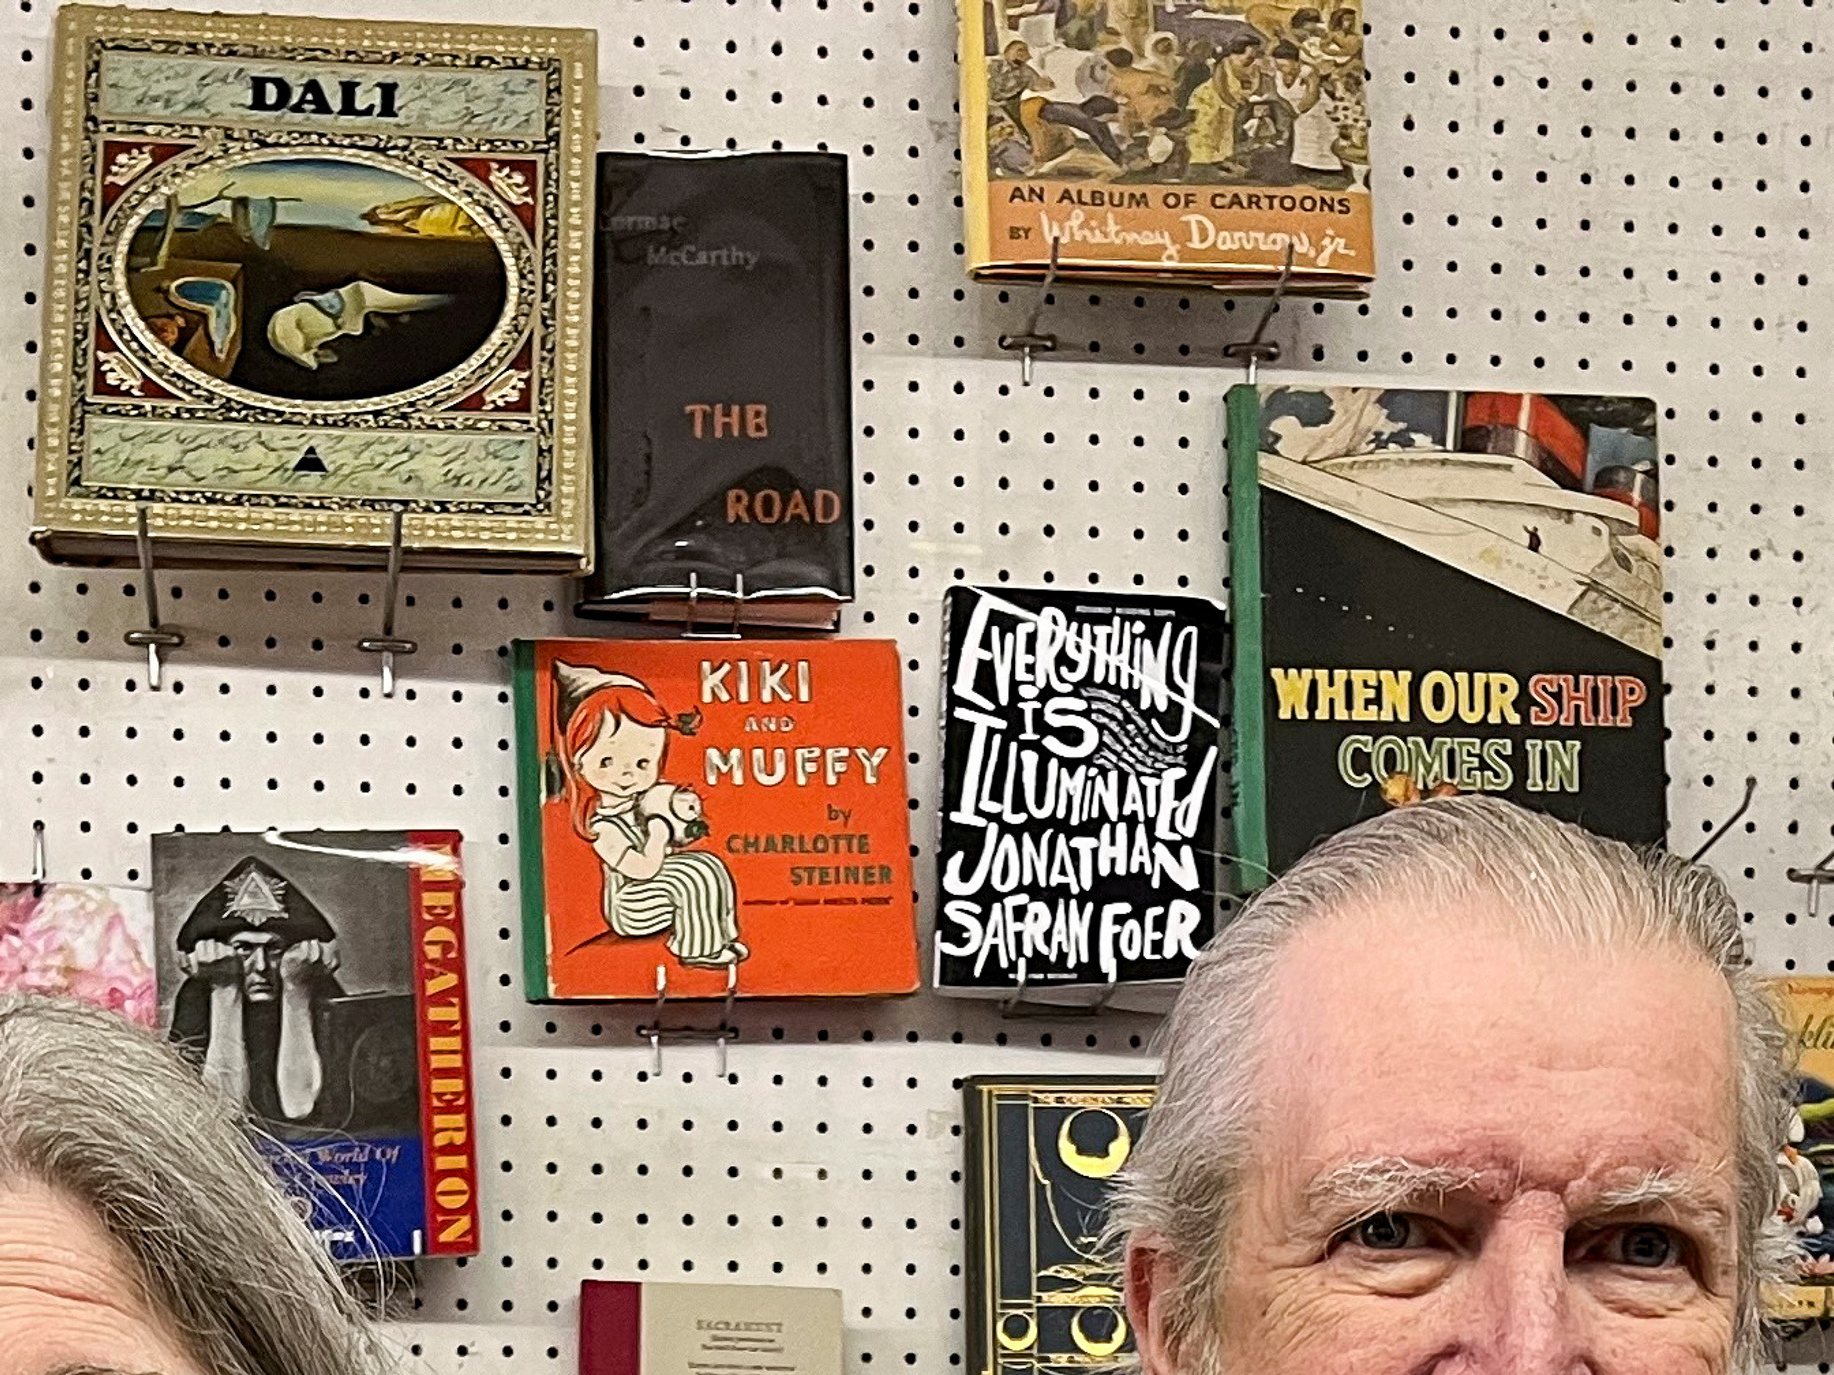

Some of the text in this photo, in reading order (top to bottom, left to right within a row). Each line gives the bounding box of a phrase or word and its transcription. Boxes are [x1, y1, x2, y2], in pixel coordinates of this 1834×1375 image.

[248, 75, 401, 119] DALI
[1009, 185, 1352, 216] AN ALBUM OF CARTOONS
[646, 242, 761, 271] McCarthy
[1009, 211, 1179, 263] BY Whitney
[685, 404, 769, 439] THE
[727, 489, 842, 526] ROAD
[698, 659, 813, 703] KIKI
[1271, 668, 1647, 727] WHEN OUR SHIP
[744, 713, 795, 734] AND
[1017, 688, 1099, 759] IS
[705, 744, 889, 786] MUFFY
[1337, 737, 1581, 793] COMES IN
[826, 802, 852, 827] by
[726, 833, 871, 856] CHARLOTTE
[943, 828, 1200, 895] JONATHAN
[789, 864, 894, 886] STEINER
[940, 894, 1202, 977] SAFRAN FOER
